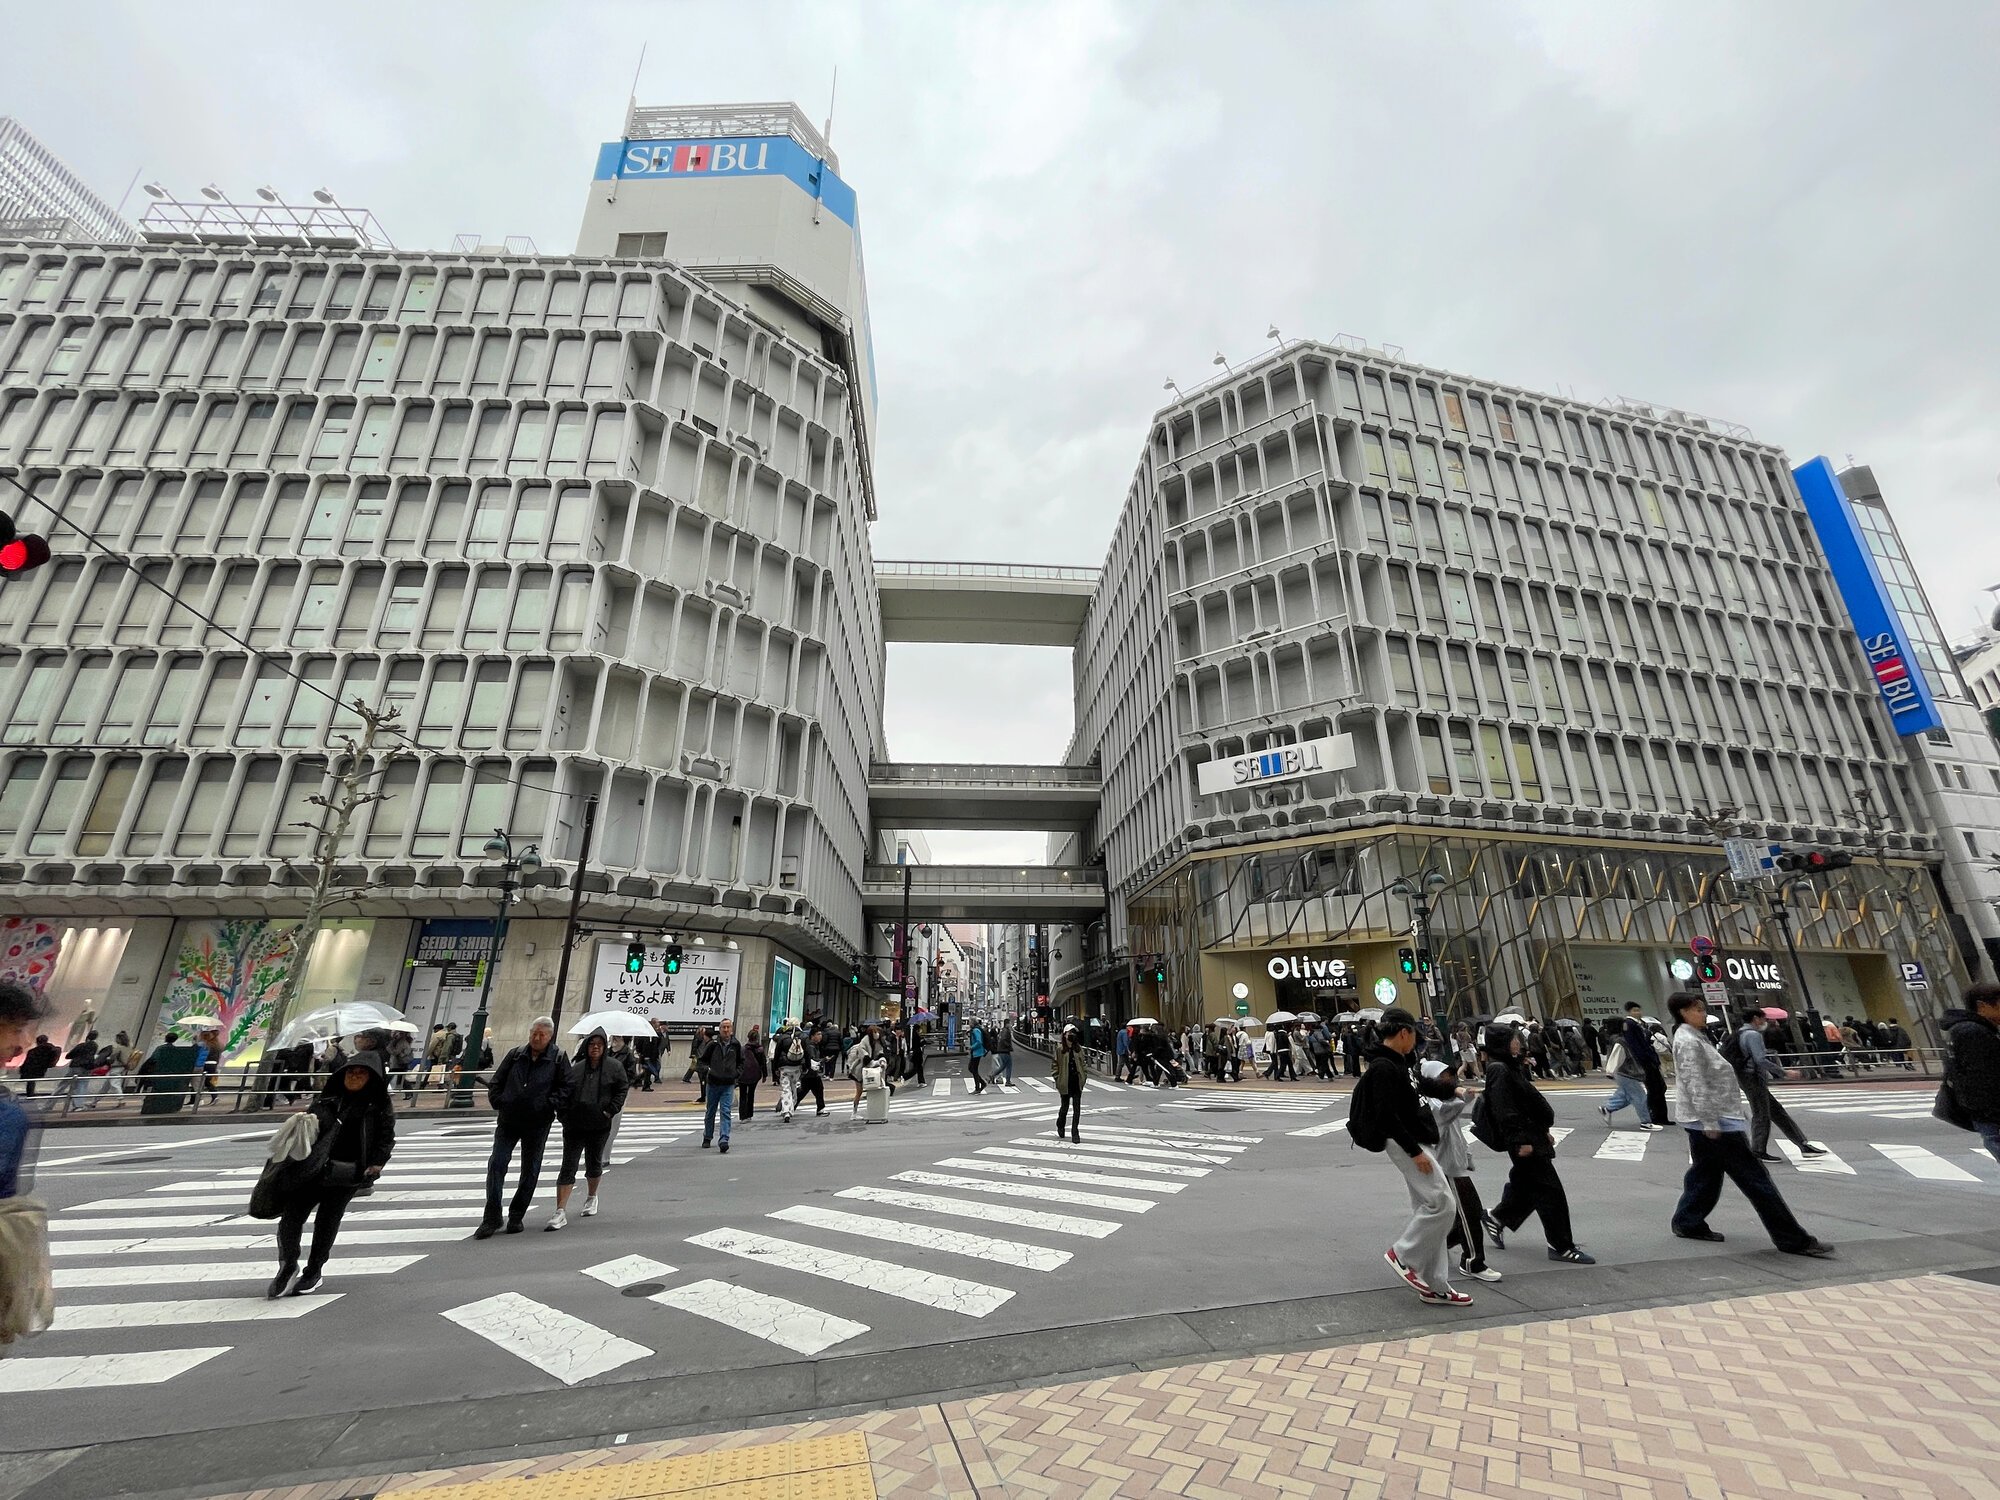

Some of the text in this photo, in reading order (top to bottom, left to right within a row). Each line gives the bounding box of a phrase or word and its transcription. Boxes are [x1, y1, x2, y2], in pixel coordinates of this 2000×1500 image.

[623, 142, 768, 174] SEIBU
[1864, 632, 1920, 715] SEIBU
[1232, 744, 1323, 785] SEIBU
[1410, 920, 1419, 936] 3
[420, 936, 457, 950] SEIBU
[1267, 955, 1347, 980] Olive
[1726, 958, 1780, 981] Olive
[1901, 963, 1918, 980] P
[620, 972, 663, 987] いい人
[1305, 978, 1348, 988] LOUNGE
[603, 988, 676, 1005] すぎるよ展
[694, 976, 724, 1006] 微
[627, 1006, 649, 1014] 2026
[692, 1007, 722, 1016] わかる展
